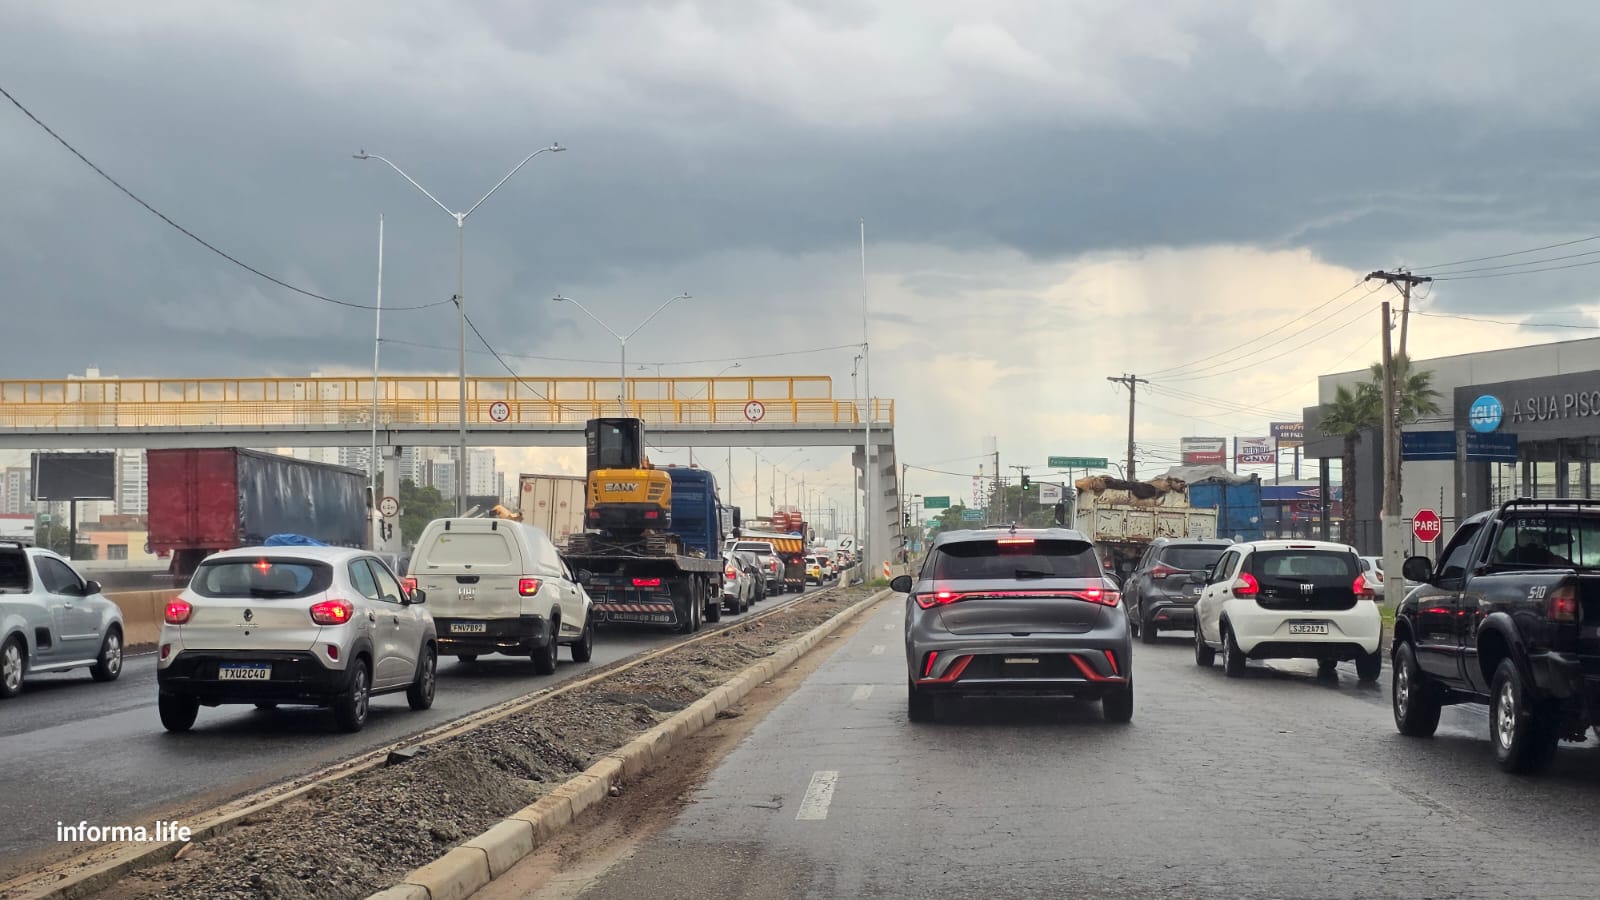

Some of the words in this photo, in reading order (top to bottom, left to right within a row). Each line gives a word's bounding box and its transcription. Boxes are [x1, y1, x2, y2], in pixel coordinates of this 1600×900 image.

[1512, 401, 1523, 424] A
[1527, 396, 1560, 422] SUA
[605, 483, 639, 492] SANY
[1414, 520, 1439, 531] PARE
[1528, 586, 1547, 599] S-10
